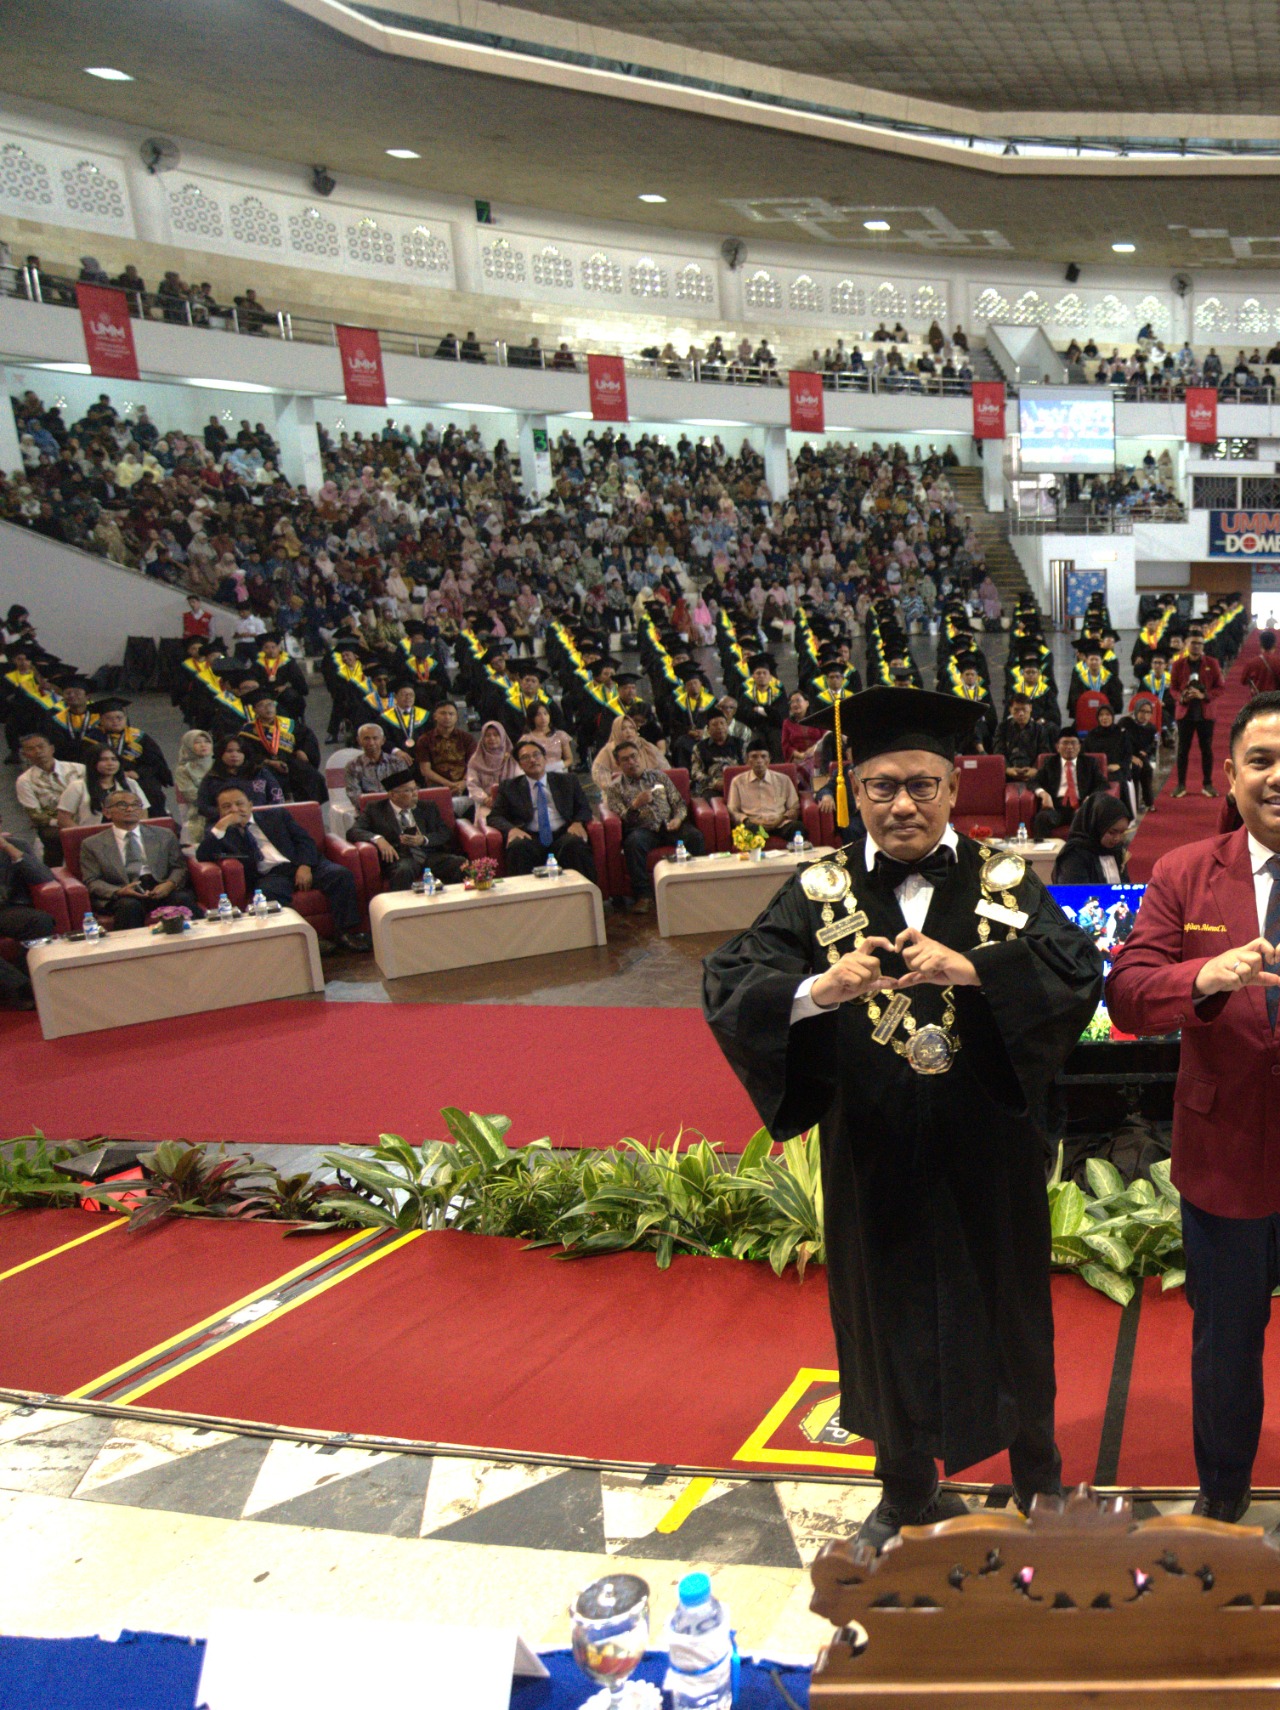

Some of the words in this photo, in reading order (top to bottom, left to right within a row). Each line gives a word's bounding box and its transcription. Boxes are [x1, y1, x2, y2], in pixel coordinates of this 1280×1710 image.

[89, 320, 126, 339] UMM
[348, 356, 378, 371] UMM
[594, 379, 621, 391] UMM
